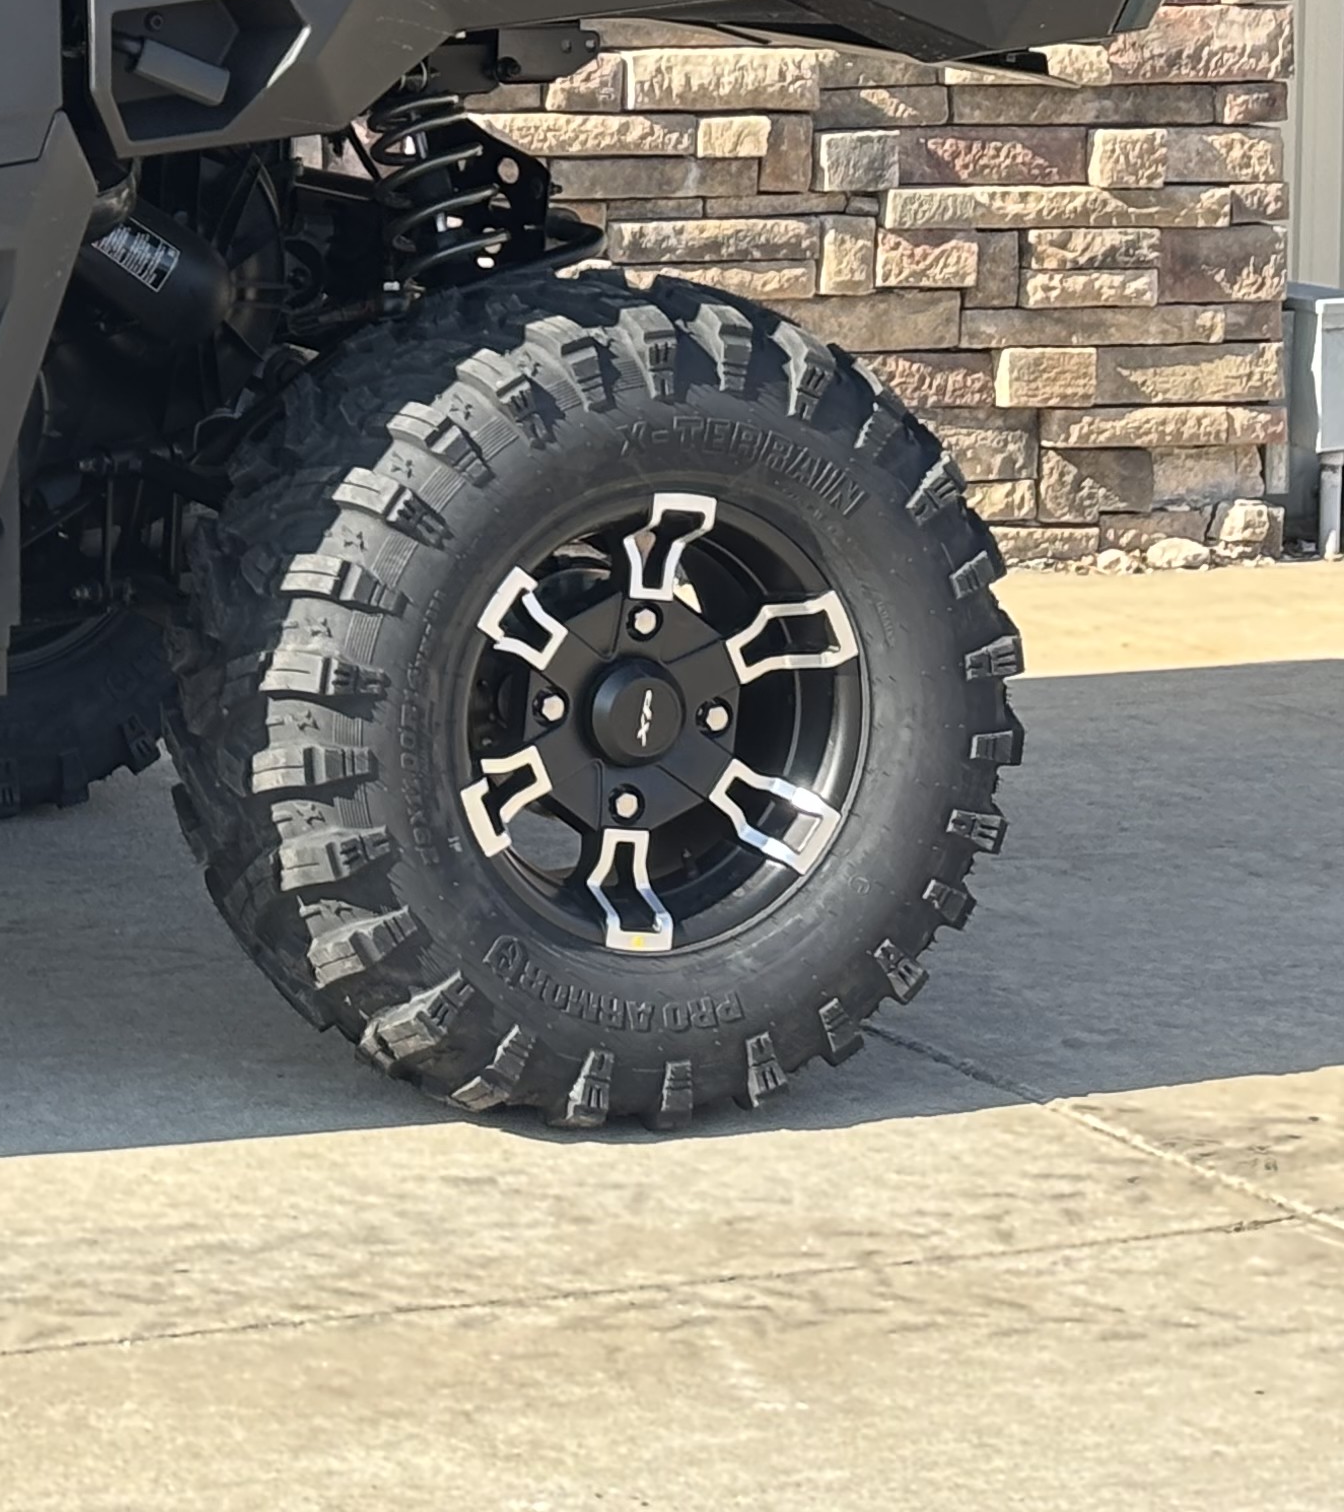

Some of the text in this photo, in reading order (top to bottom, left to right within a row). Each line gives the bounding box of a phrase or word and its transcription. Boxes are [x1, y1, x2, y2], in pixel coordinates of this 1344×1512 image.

[615, 415, 866, 517] X-TERRAIN
[637, 689, 653, 747] XP
[519, 960, 745, 1032] PRO ARMOR
